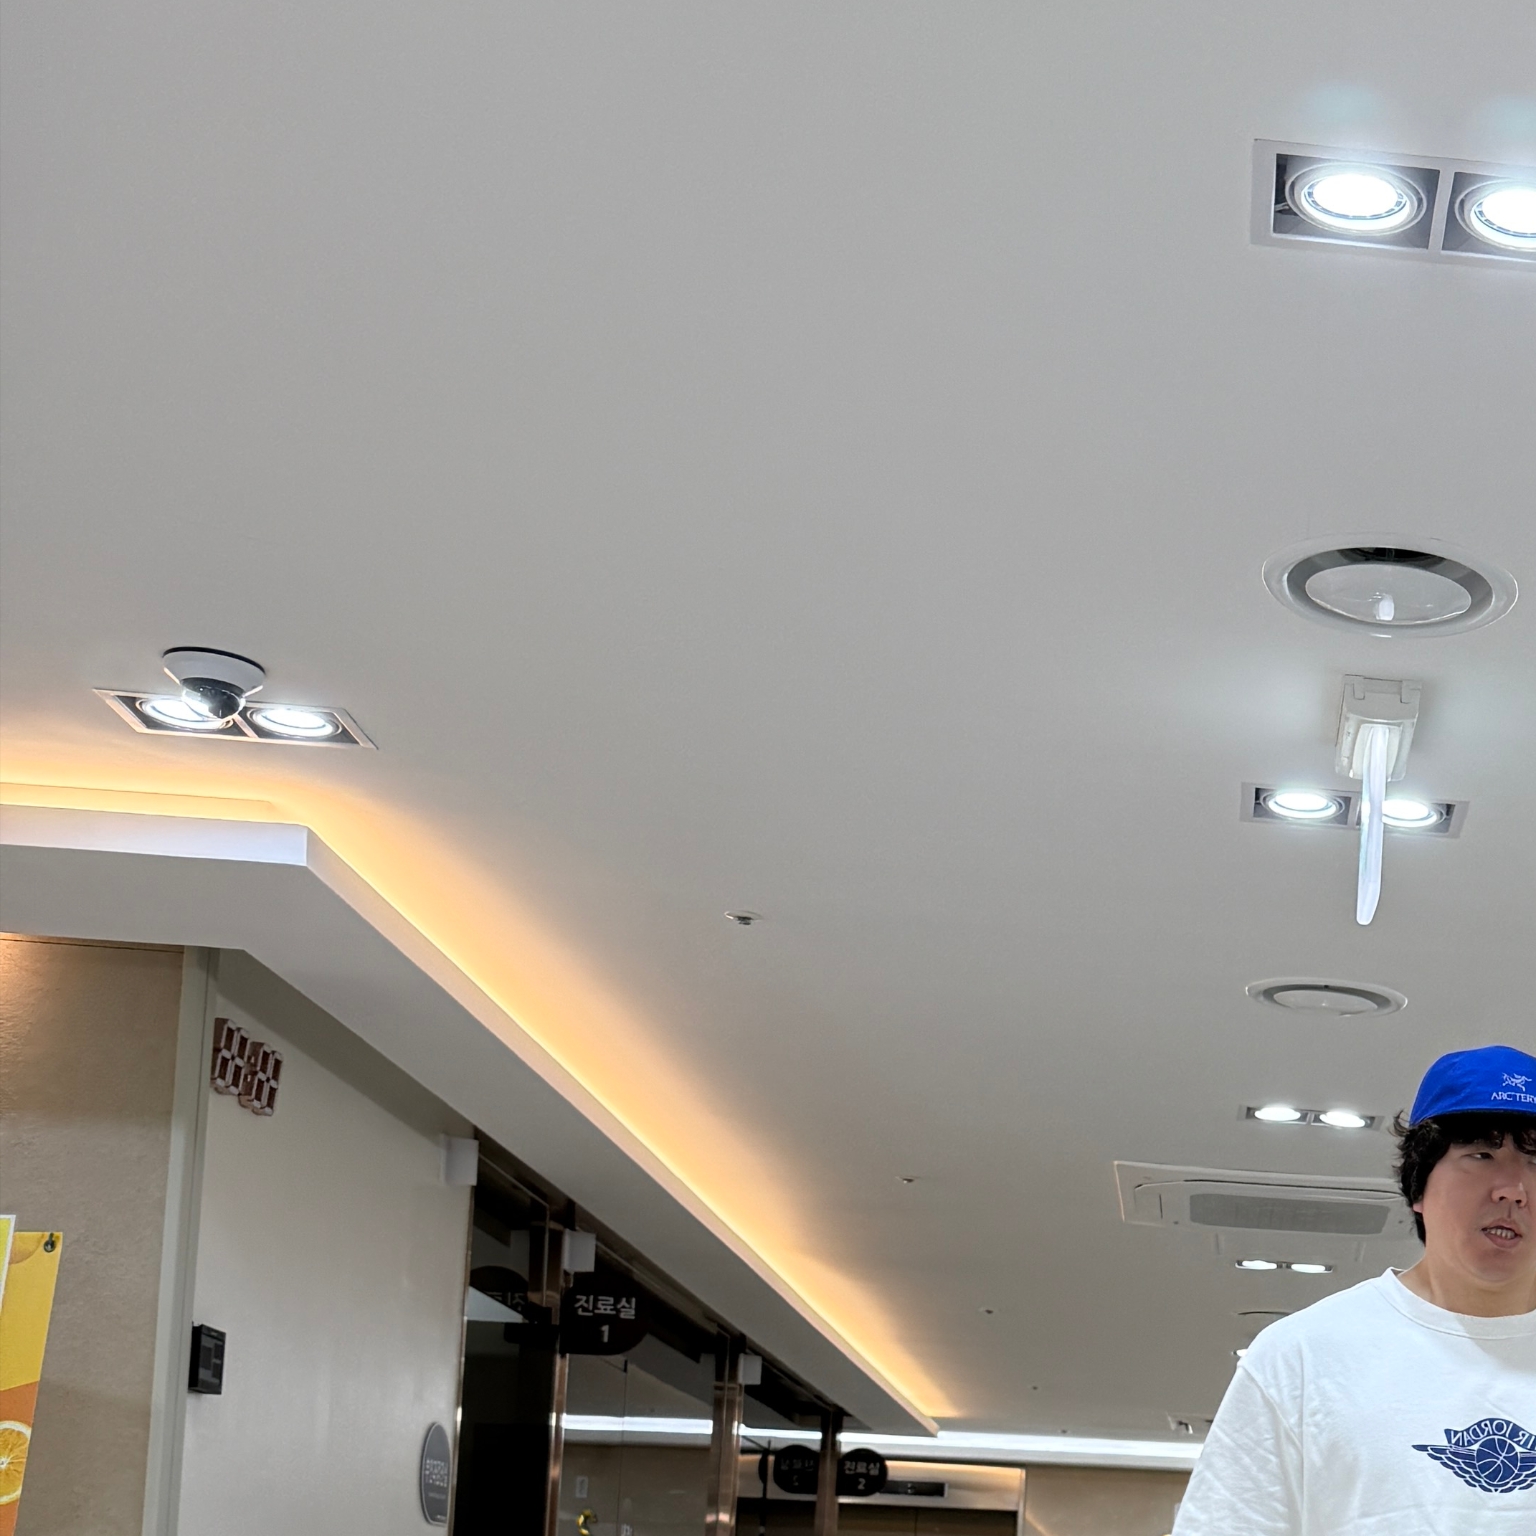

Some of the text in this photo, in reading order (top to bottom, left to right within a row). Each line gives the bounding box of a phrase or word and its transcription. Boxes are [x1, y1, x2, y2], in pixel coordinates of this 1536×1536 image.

[574, 1294, 636, 1319] 진료실
[599, 1324, 610, 1343] 1
[844, 1461, 880, 1476] 진료실
[857, 1477, 866, 1490] 2
